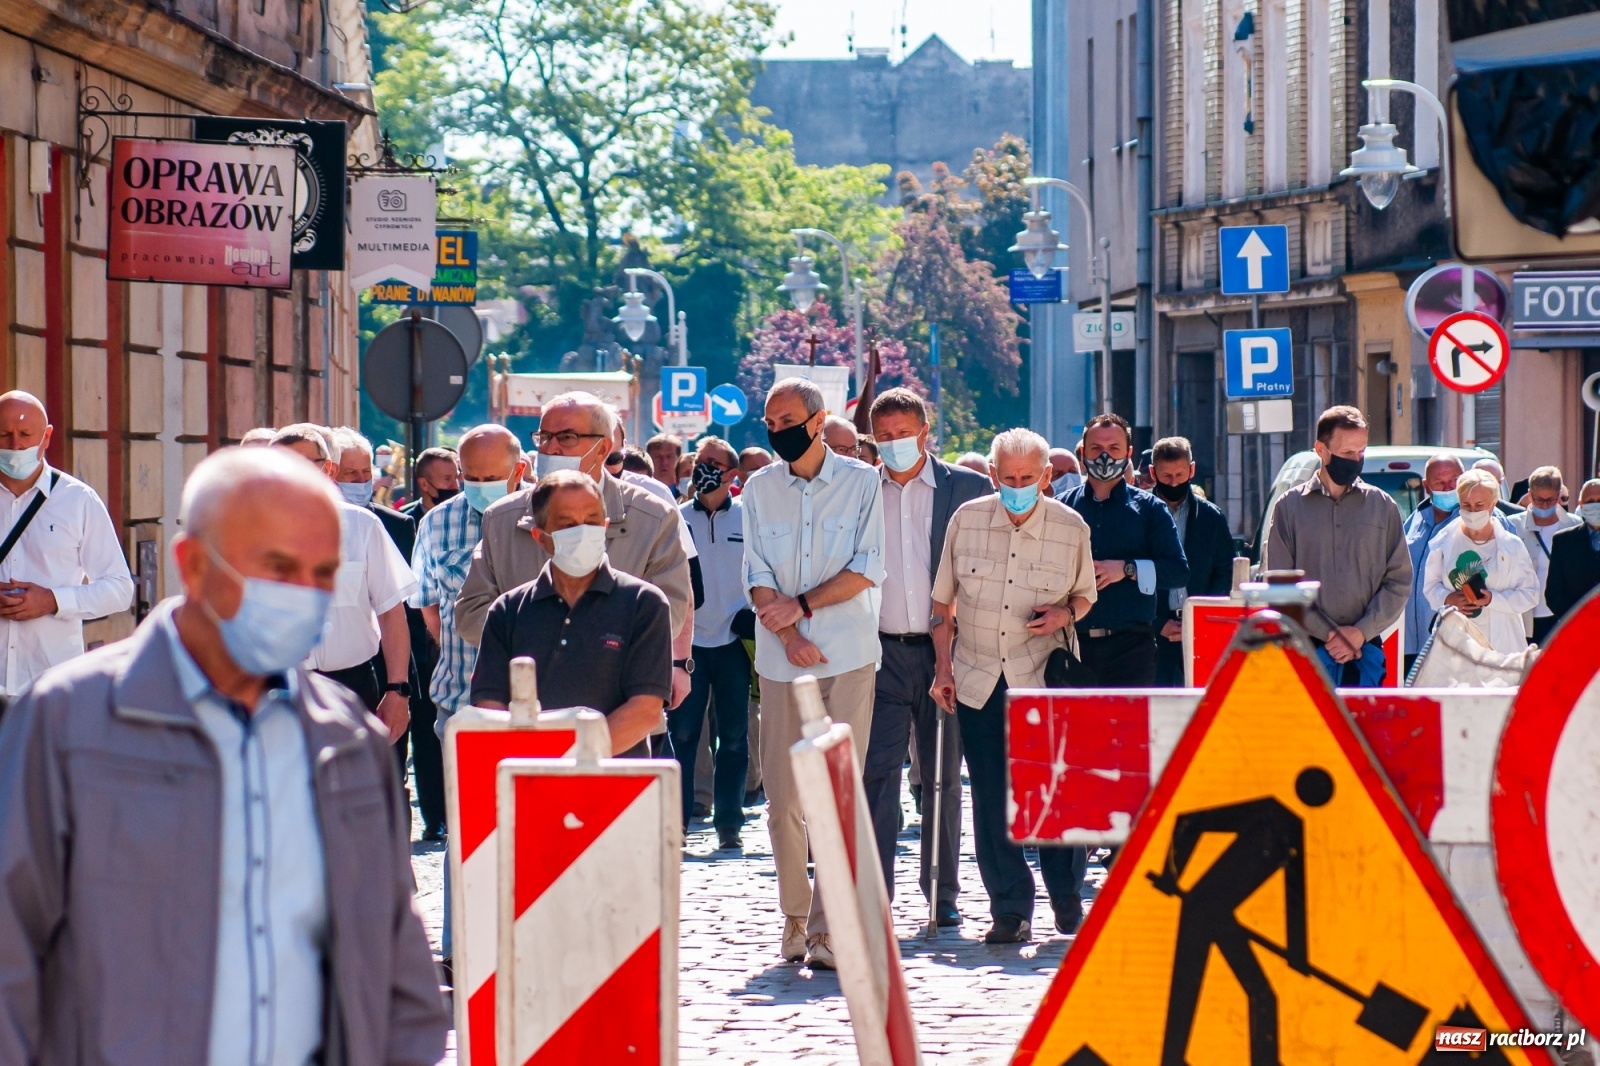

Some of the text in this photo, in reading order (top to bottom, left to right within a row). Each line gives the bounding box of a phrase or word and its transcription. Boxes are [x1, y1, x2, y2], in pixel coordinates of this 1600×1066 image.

[123, 157, 284, 197] OPRAWA
[121, 196, 283, 232] OBRAZÓW
[121, 252, 215, 265] pracownia
[224, 245, 269, 266] Nowiny
[357, 242, 430, 252] MULTIMEDIA
[231, 255, 281, 278] art
[370, 284, 412, 302] PRANIE
[1524, 286, 1600, 317] FOTO
[1240, 336, 1279, 389] P
[671, 372, 697, 407] P
[1256, 382, 1291, 393] Płatny
